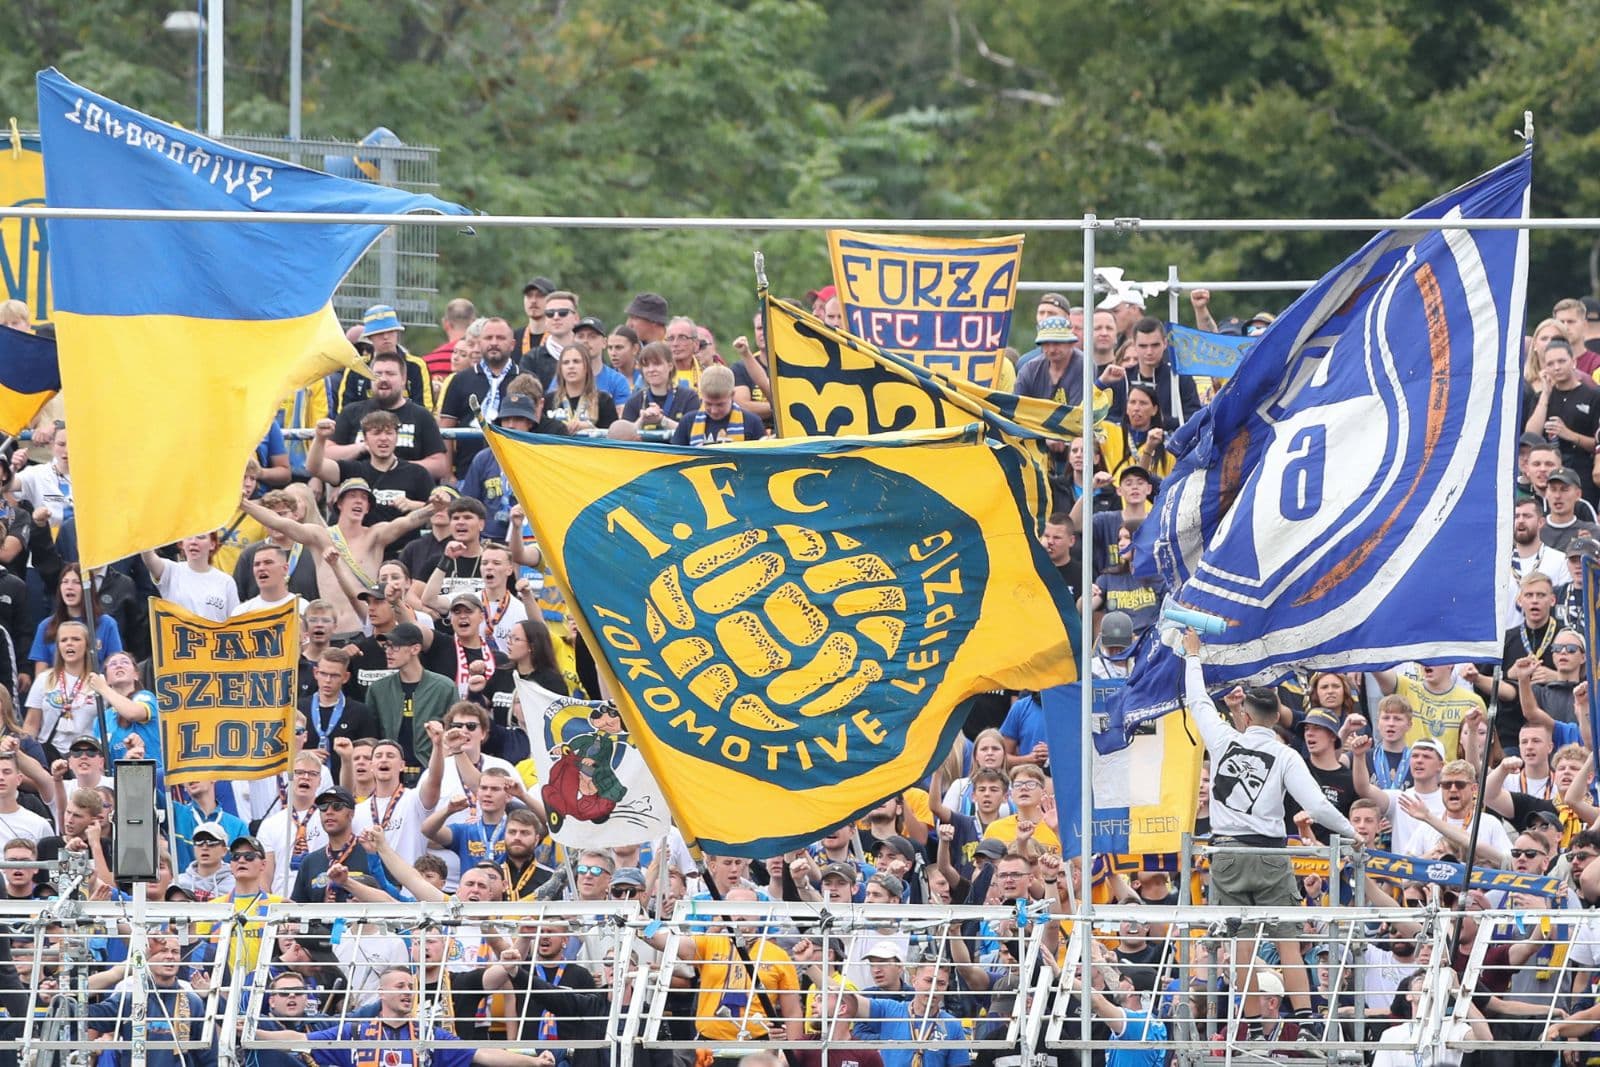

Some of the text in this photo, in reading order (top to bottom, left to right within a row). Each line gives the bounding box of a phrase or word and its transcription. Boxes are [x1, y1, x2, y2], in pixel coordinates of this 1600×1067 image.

[842, 254, 1016, 308] FORZA
[934, 313, 1002, 349] LOK
[890, 530, 964, 695] LEIPZIG
[172, 623, 286, 662] FAN
[593, 604, 888, 771] LOKOMOTIVE
[177, 719, 290, 761] LOK
